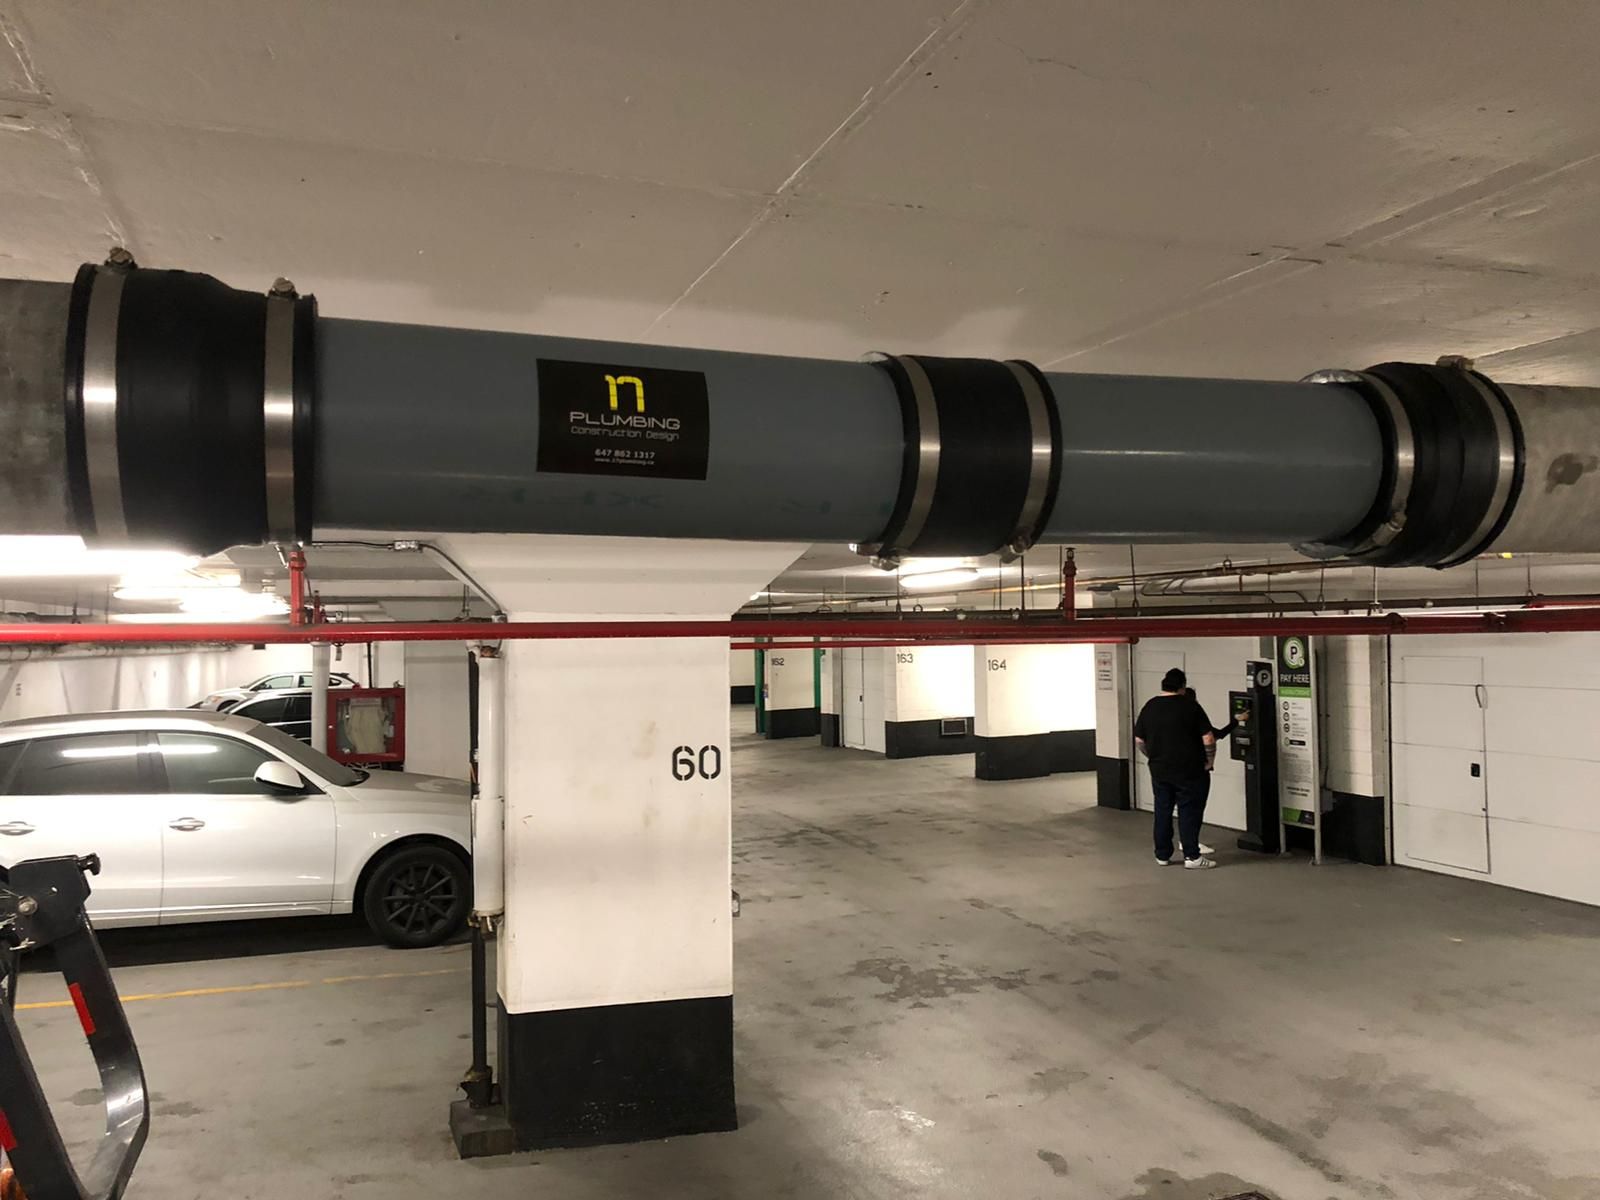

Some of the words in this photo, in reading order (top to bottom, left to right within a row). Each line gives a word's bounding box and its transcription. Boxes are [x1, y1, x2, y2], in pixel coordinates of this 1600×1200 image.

[569, 411, 681, 430] PLUMBING
[570, 425, 642, 438] Construction
[645, 430, 680, 442] Design
[594, 448, 612, 457] 647
[634, 450, 656, 459] 1317
[987, 659, 1007, 671] 164
[1280, 674, 1292, 683] PAY
[1293, 674, 1310, 684] HERE
[672, 745, 721, 781] 60
